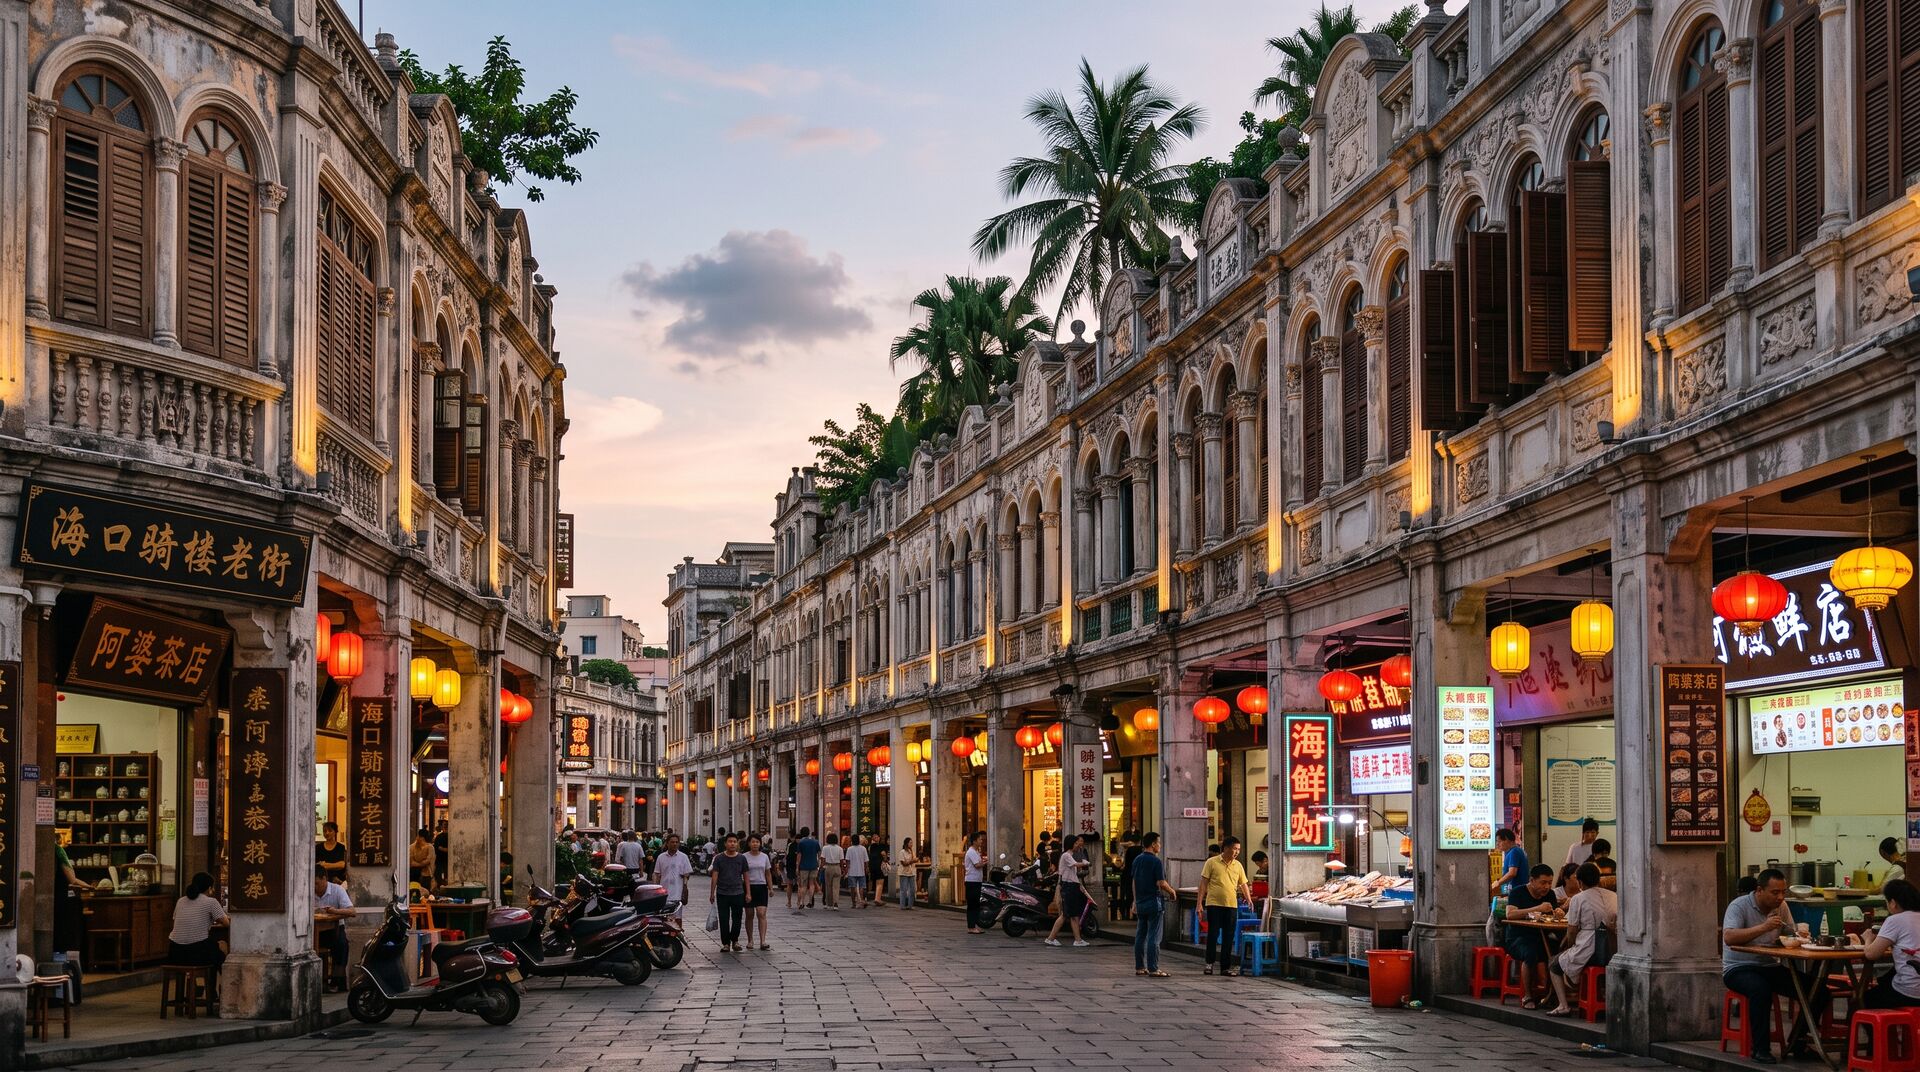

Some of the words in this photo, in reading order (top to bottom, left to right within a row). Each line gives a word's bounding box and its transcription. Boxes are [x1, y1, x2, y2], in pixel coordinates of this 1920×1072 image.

[50, 505, 292, 588] 海口骑楼老街
[91, 622, 212, 685] 阿婆茶店
